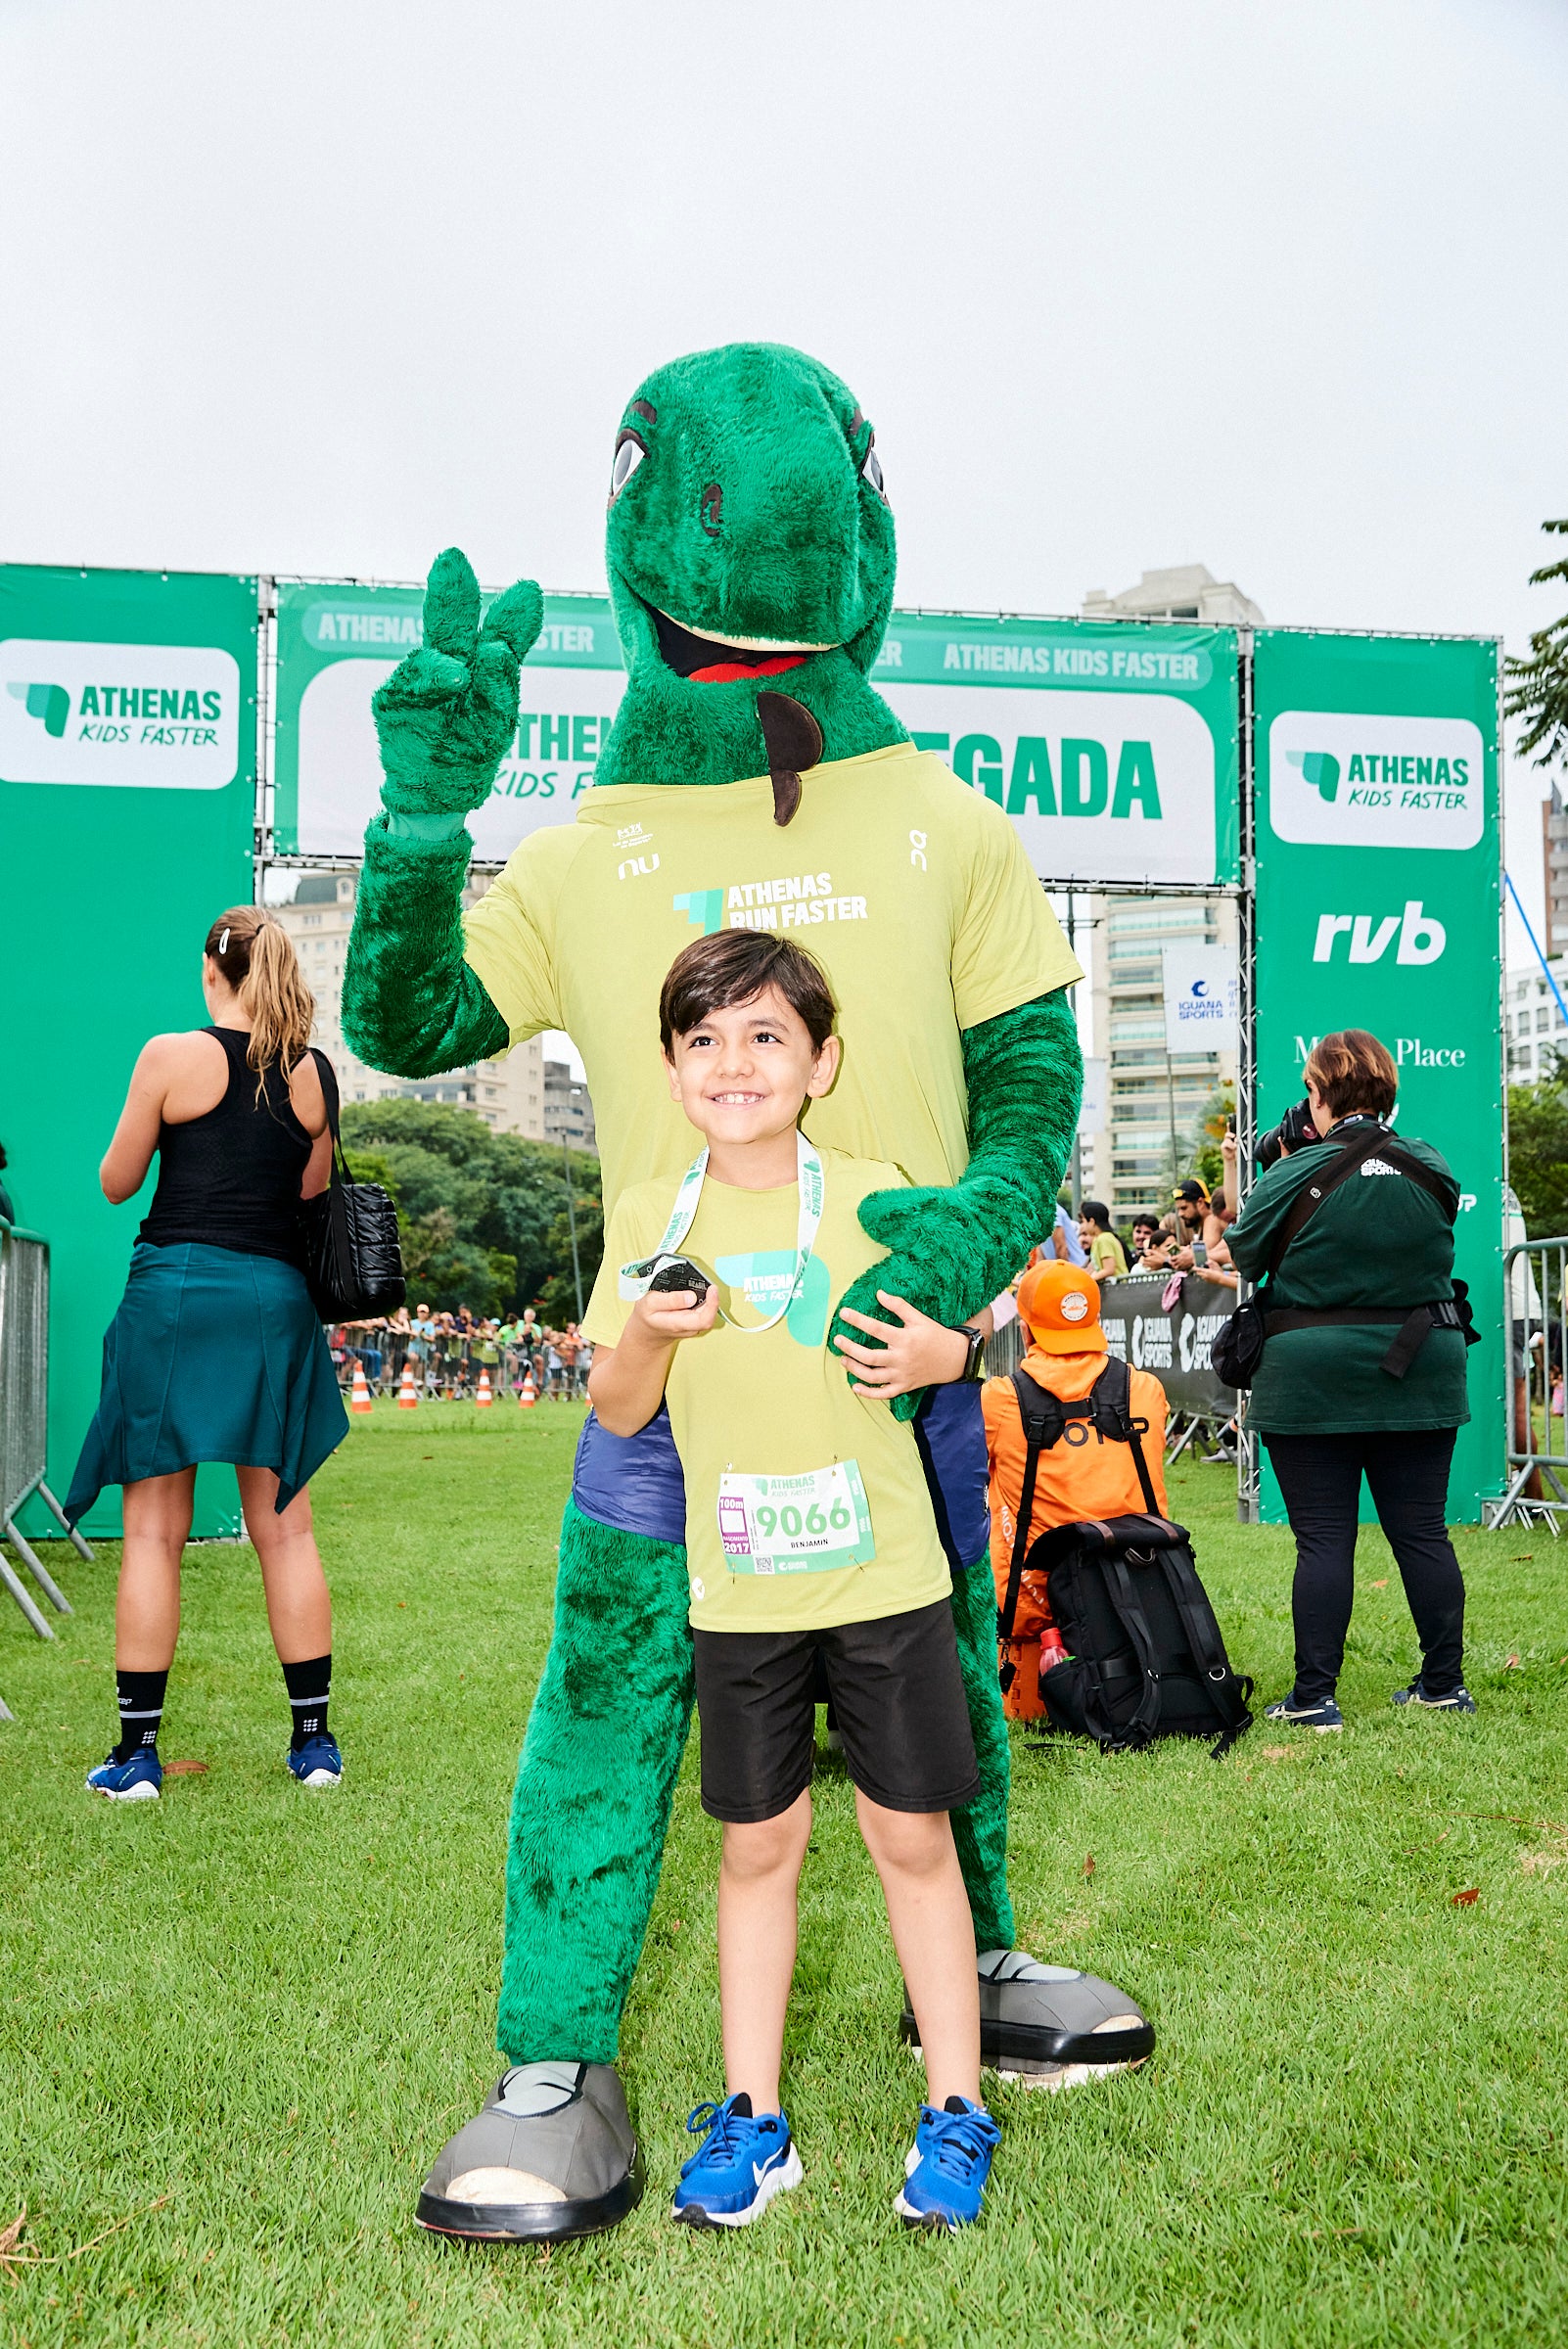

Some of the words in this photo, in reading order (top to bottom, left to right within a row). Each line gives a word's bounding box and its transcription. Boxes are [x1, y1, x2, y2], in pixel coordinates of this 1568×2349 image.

[534, 623, 595, 653] STER
[944, 643, 1050, 674] ATHENAS
[1053, 648, 1109, 676] KIDS
[1112, 651, 1199, 681] FASTER
[79, 686, 221, 721] ATHENAS
[79, 722, 132, 743] KIDS
[140, 725, 219, 747] FASTER
[912, 731, 1163, 820] GADA
[1348, 754, 1469, 787] ATHENAS
[1348, 789, 1393, 806] KIDS
[1401, 790, 1468, 810] FASTER
[727, 872, 833, 909] ATHENAS
[729, 906, 778, 931] RUN
[781, 896, 868, 929] FASTER
[1313, 900, 1447, 966] rvb
[1178, 1000, 1223, 1011] IGUANA
[1178, 1010, 1224, 1021] SPORTS
[1395, 1037, 1466, 1068] Place
[810, 1174, 822, 1218] ATHENAS
[1143, 1317, 1173, 1342] IGUANA
[1143, 1343, 1173, 1369] SPORTS
[770, 1475, 815, 1490] ATHENAS
[719, 1498, 744, 1510] 100m
[756, 1497, 851, 1538] 9066
[724, 1542, 750, 1553] 2017
[790, 1538, 829, 1549] BENJAMIN
